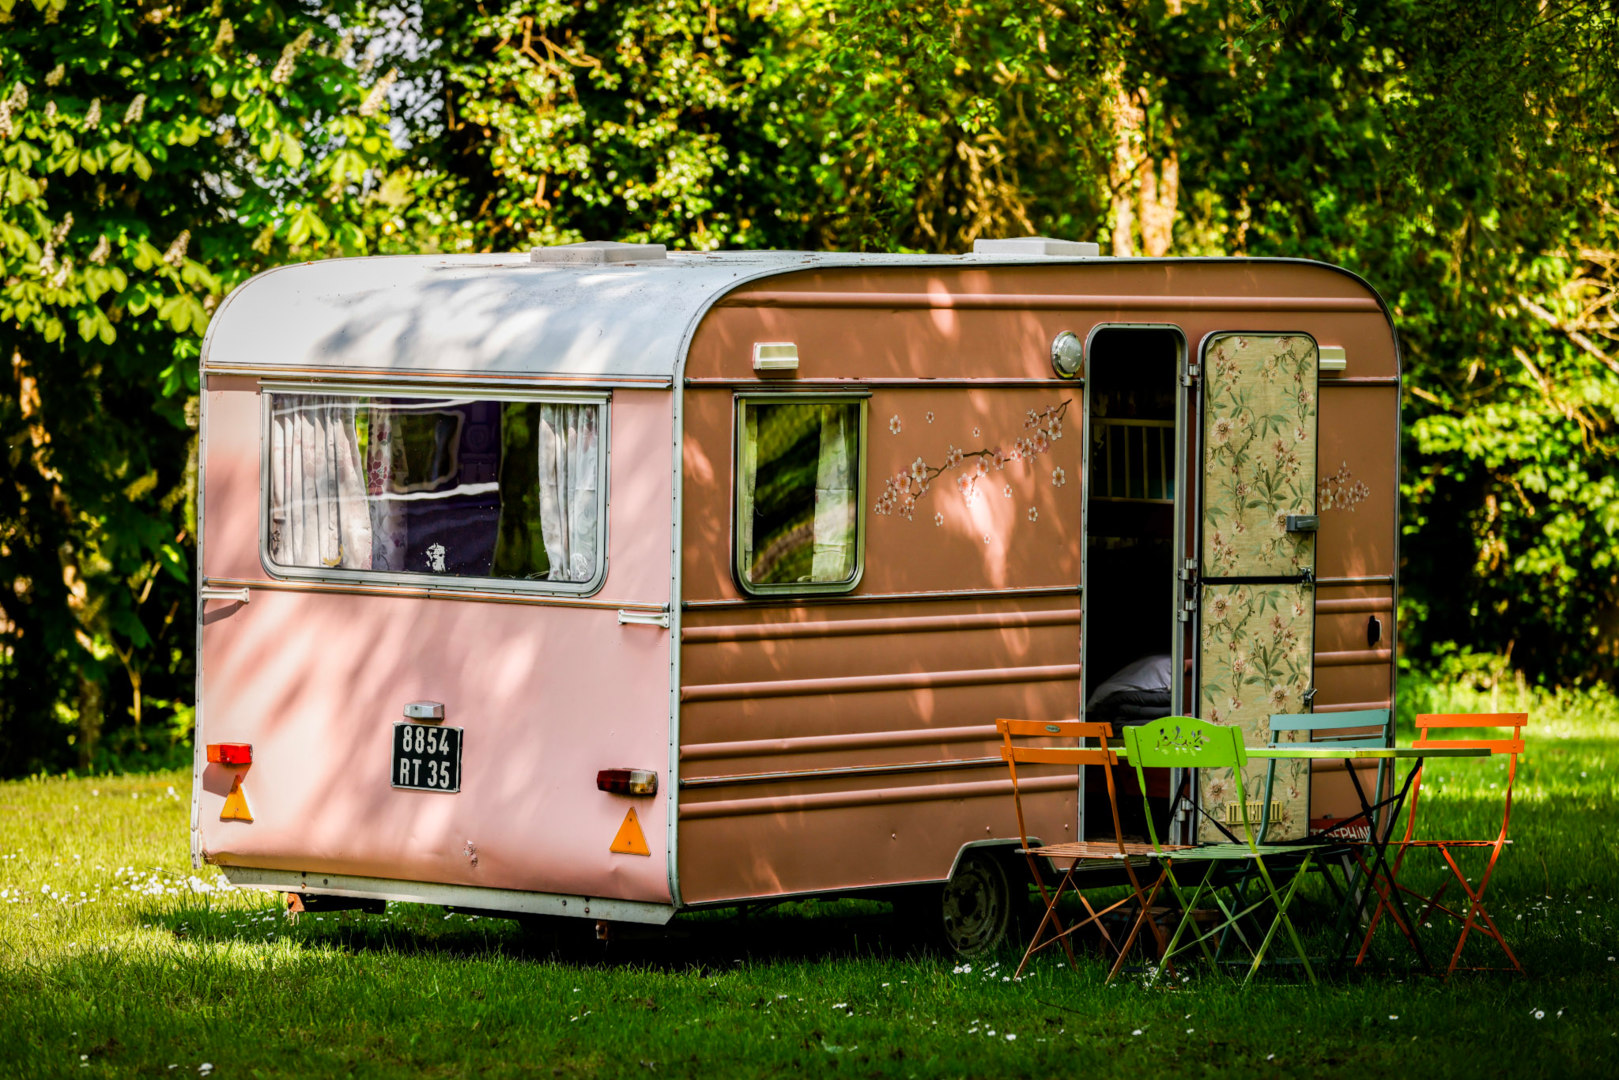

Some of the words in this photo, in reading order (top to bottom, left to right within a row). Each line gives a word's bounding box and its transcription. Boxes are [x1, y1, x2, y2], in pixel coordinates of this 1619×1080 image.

[402, 725, 450, 755] 8854
[399, 757, 422, 785] RT
[427, 760, 450, 788] 35
